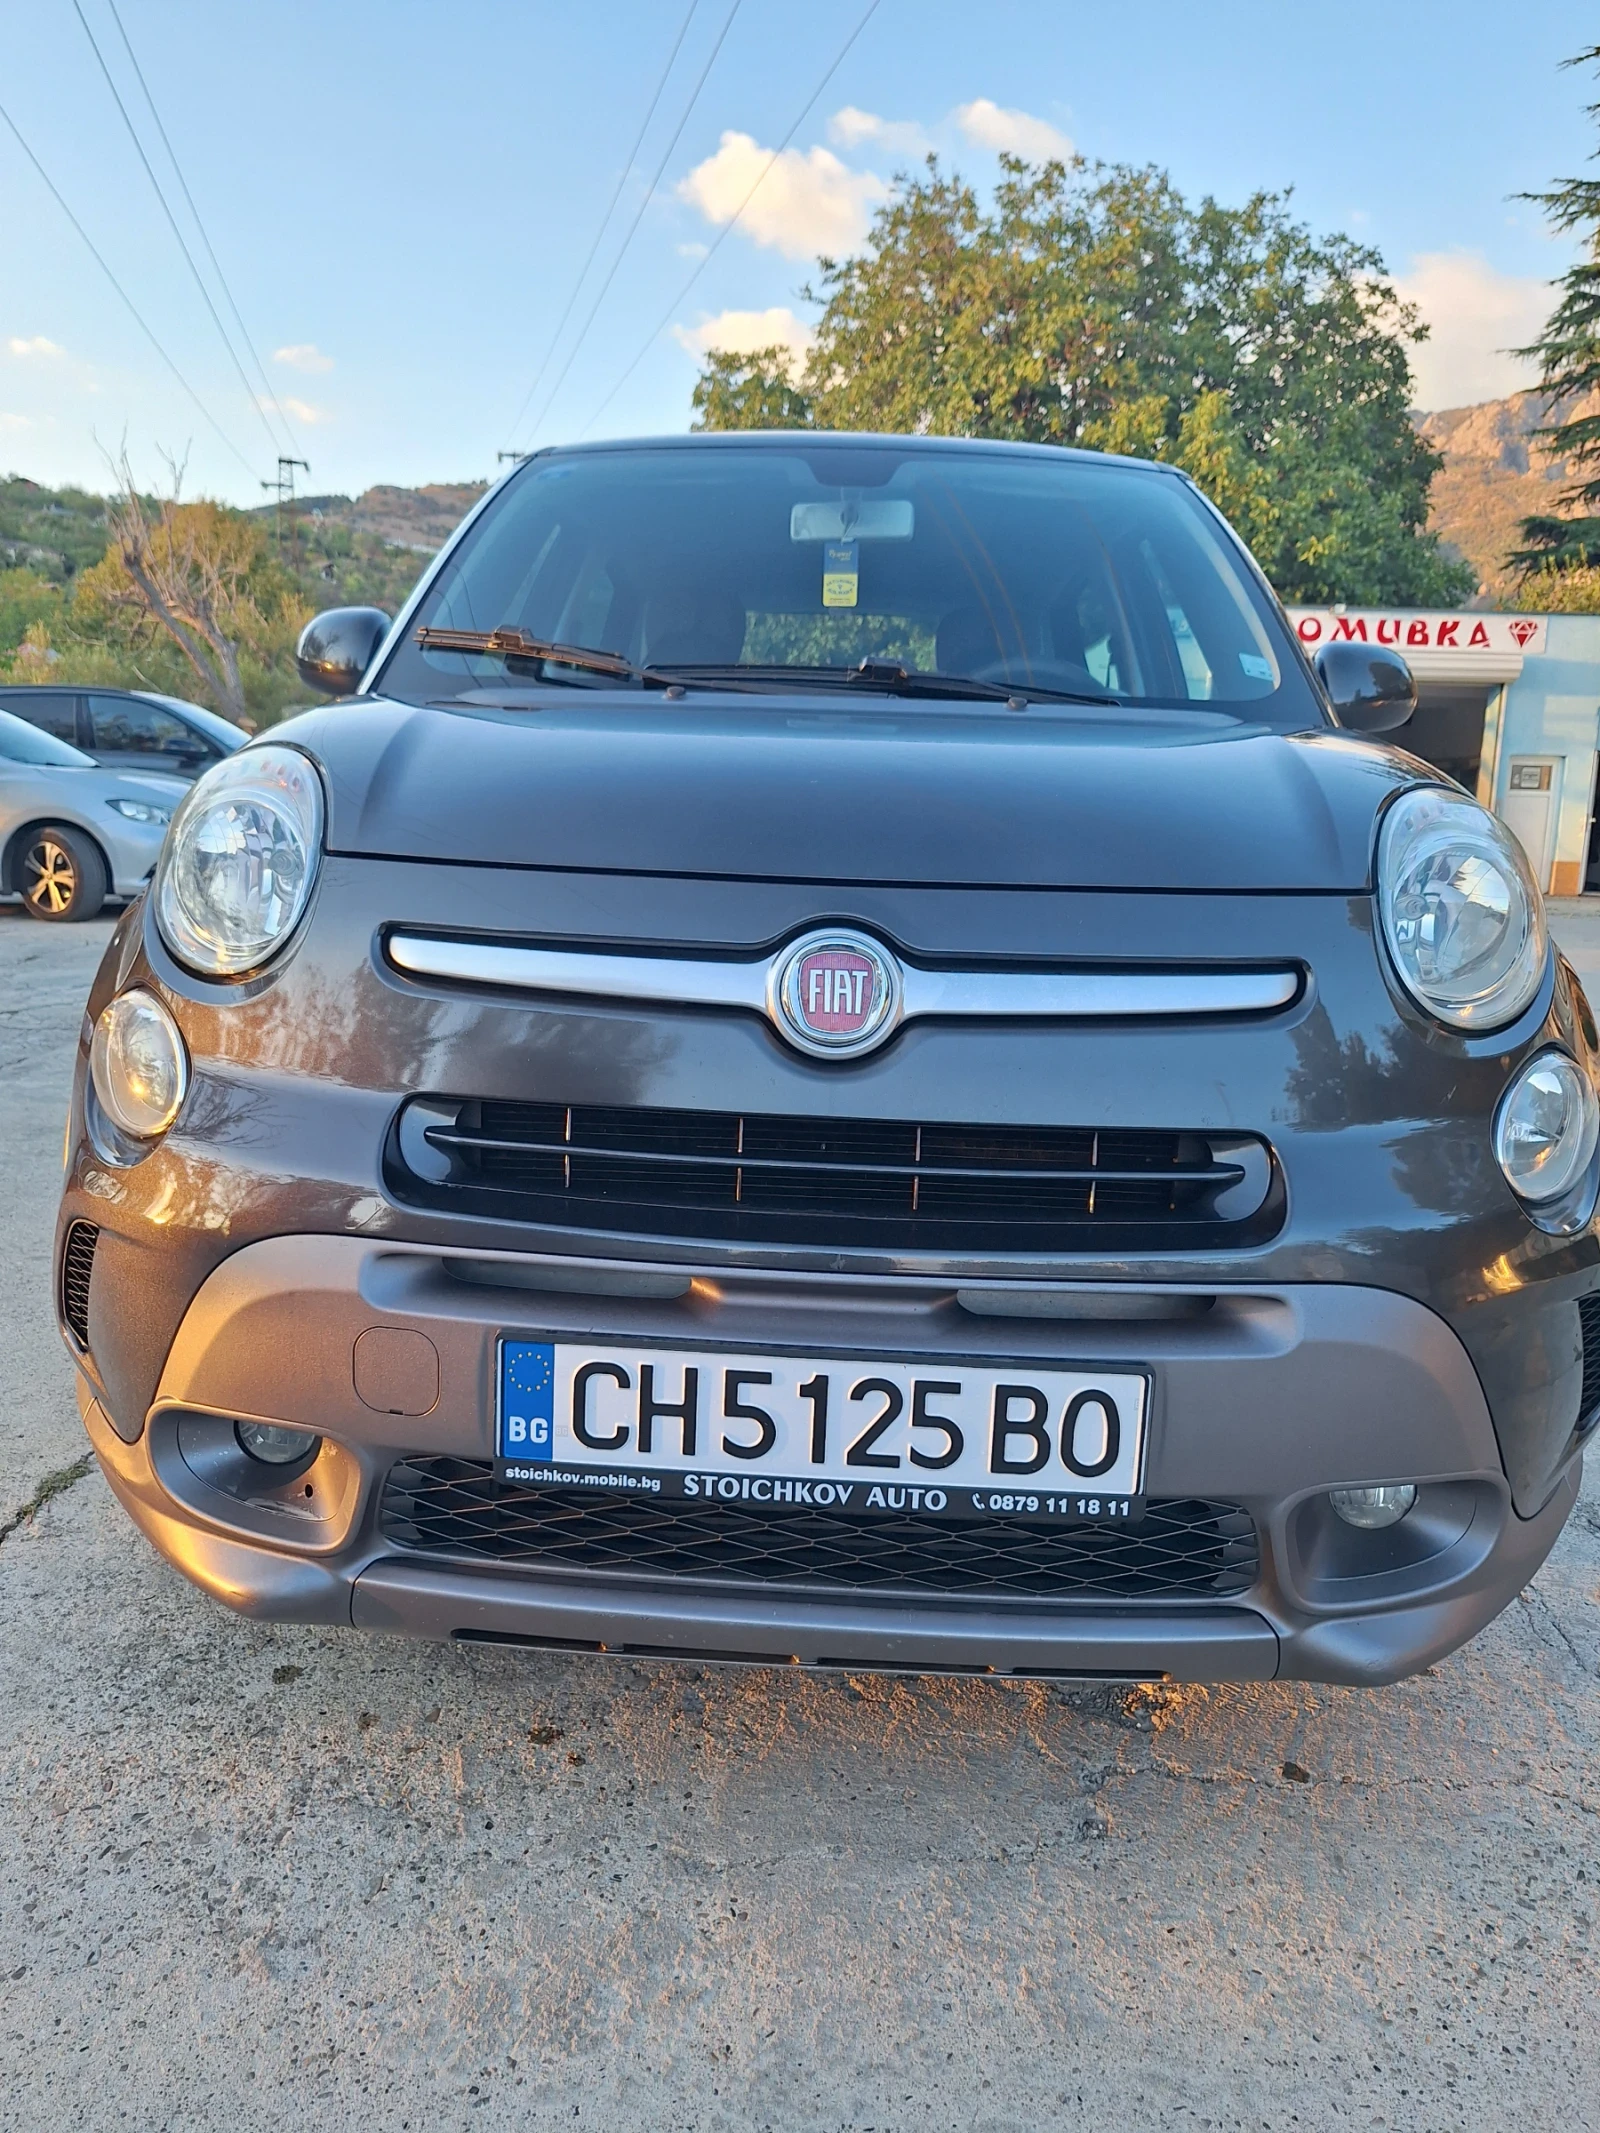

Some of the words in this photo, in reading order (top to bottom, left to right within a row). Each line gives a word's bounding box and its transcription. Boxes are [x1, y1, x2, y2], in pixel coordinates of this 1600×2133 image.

[809, 969, 868, 1015] FIAT
[509, 1416, 548, 1444] BG
[573, 1361, 699, 1456] CH
[722, 1368, 964, 1470] 5125
[505, 1466, 661, 1492] stoichkov.mobile.bg
[683, 1474, 853, 1506] STOICHKOV
[865, 1486, 947, 1511] AUTO
[989, 1494, 1039, 1512] 0879
[1046, 1498, 1067, 1514] 11
[1077, 1500, 1100, 1515] 18
[1108, 1501, 1129, 1516] 11
